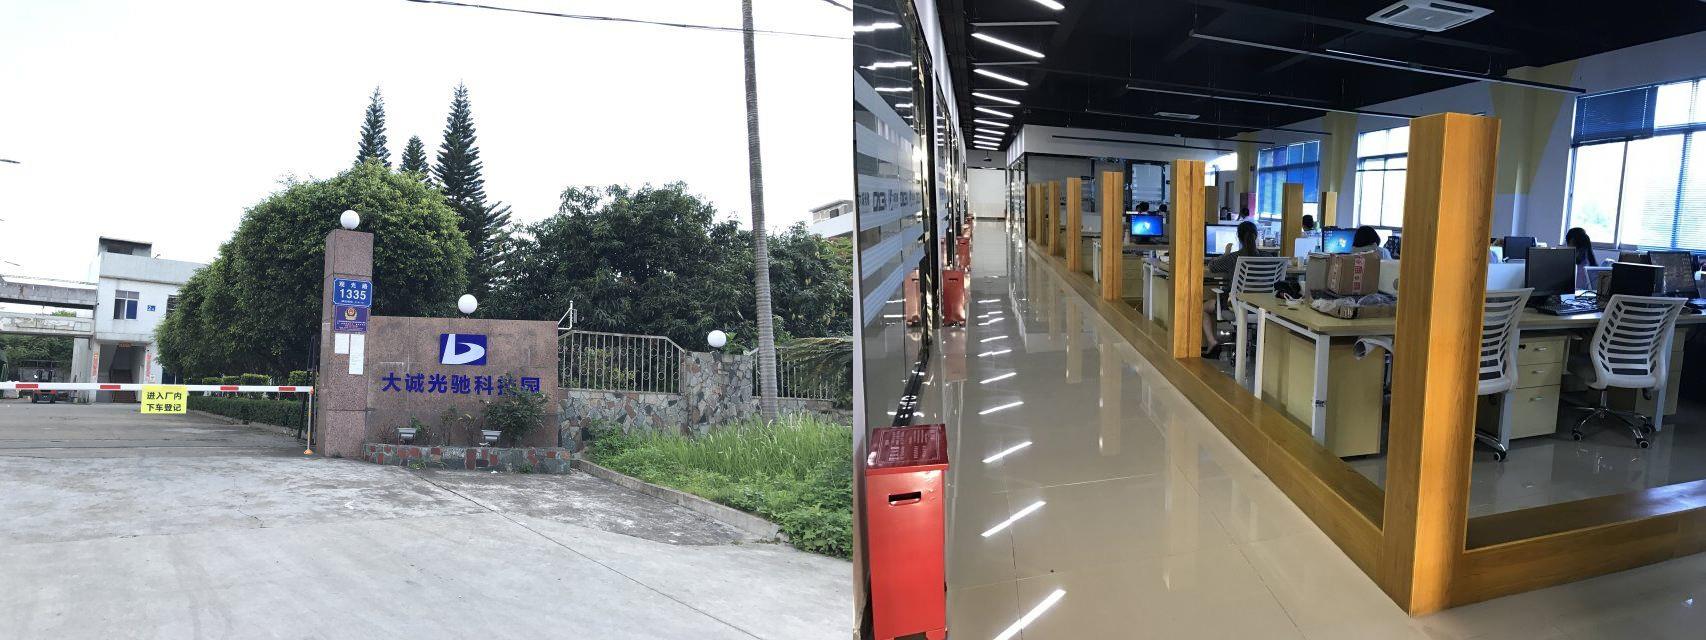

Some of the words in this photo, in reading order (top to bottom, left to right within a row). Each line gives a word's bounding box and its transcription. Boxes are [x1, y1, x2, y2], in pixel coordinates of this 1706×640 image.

[340, 289, 366, 300] 1335
[147, 391, 182, 400] 进入厂内
[147, 403, 182, 412] 下车登记
